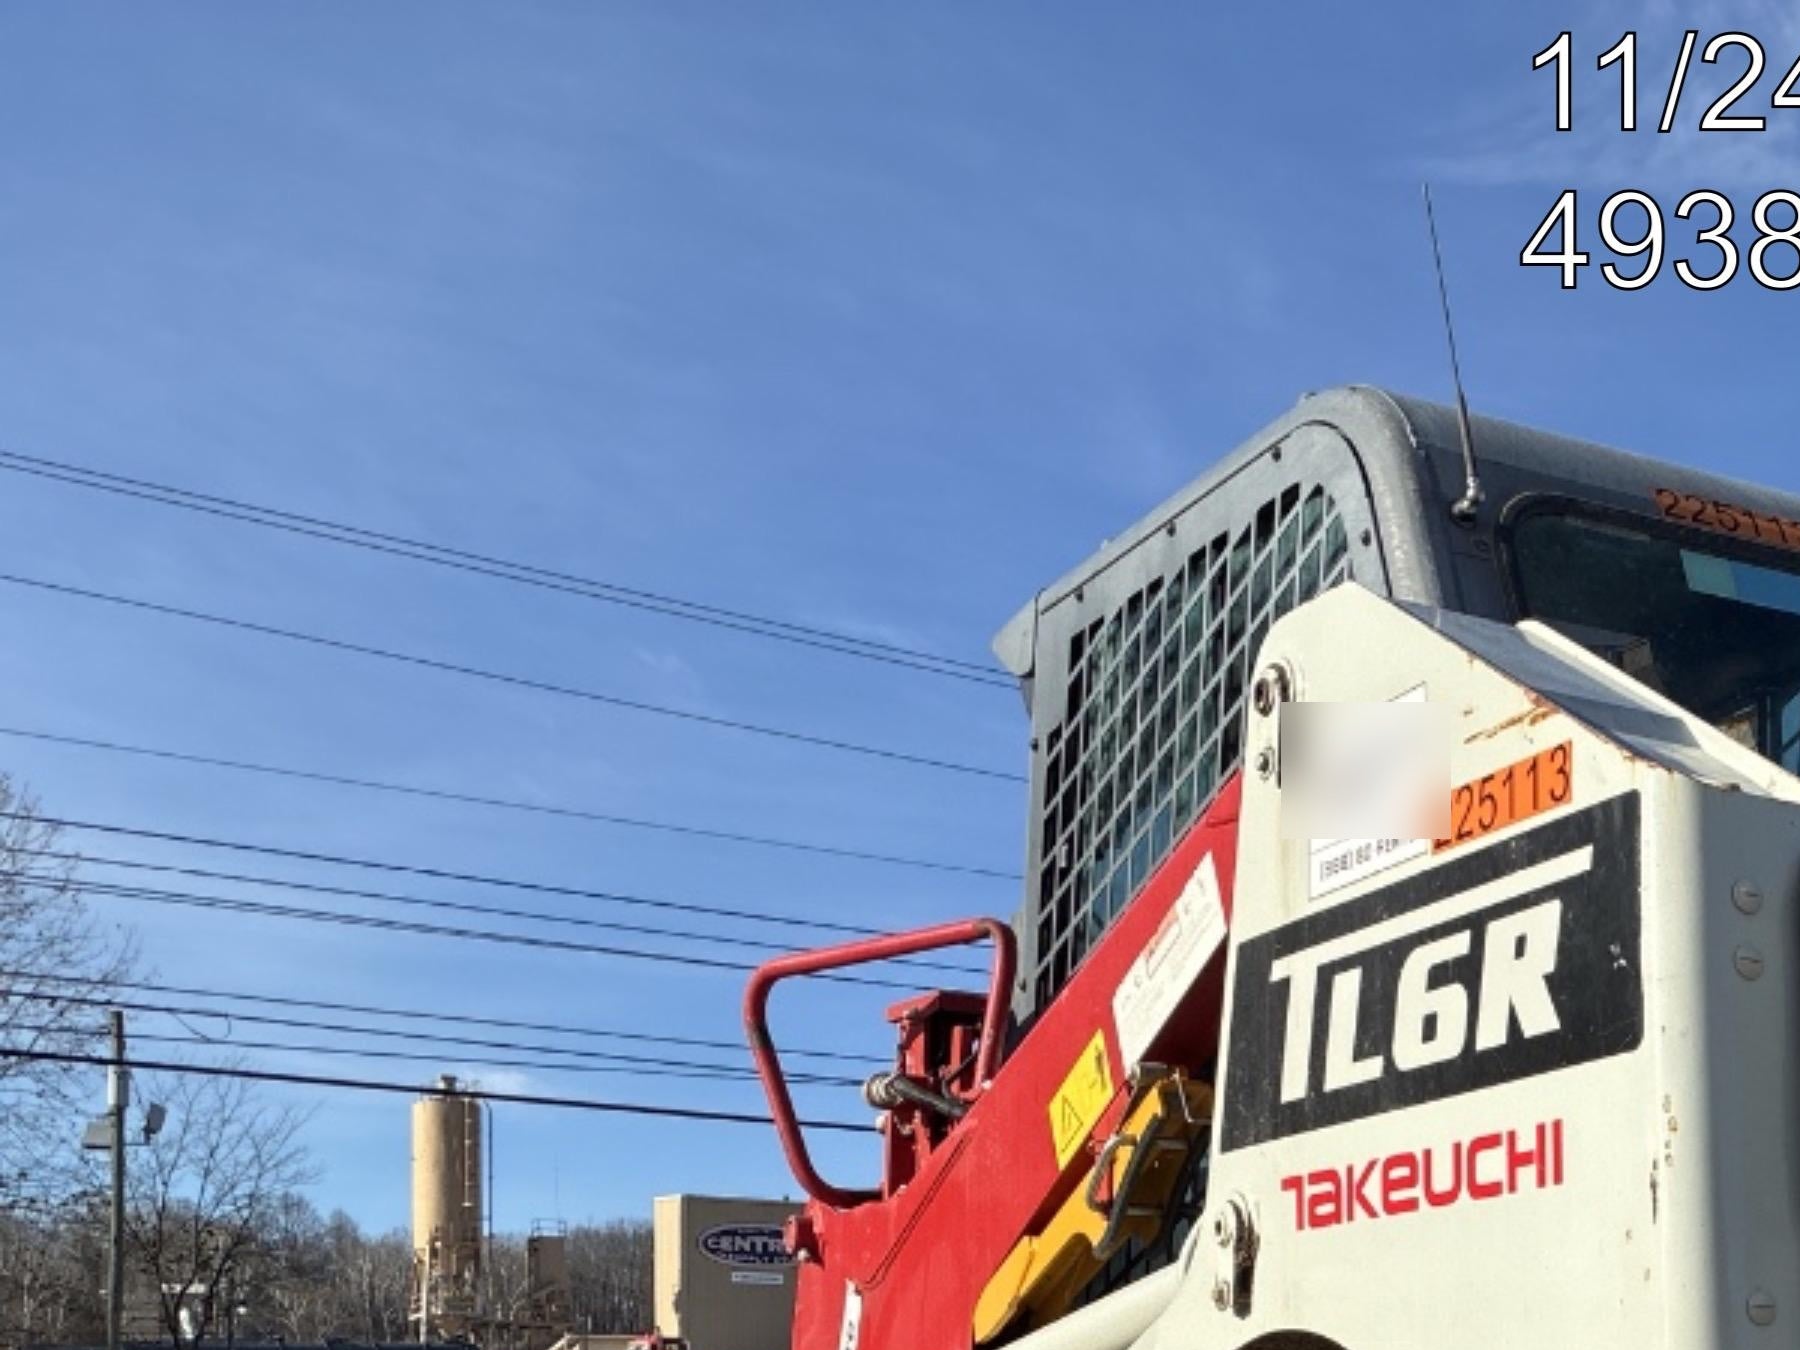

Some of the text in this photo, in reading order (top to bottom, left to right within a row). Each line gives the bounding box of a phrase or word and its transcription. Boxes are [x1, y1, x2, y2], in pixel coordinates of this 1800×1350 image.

[1433, 743, 1570, 850] 25113
[1270, 845, 1594, 1105] TL6R
[1281, 1119, 1565, 1232] TAKEUCHI
[707, 1235, 784, 1254] CENTR
